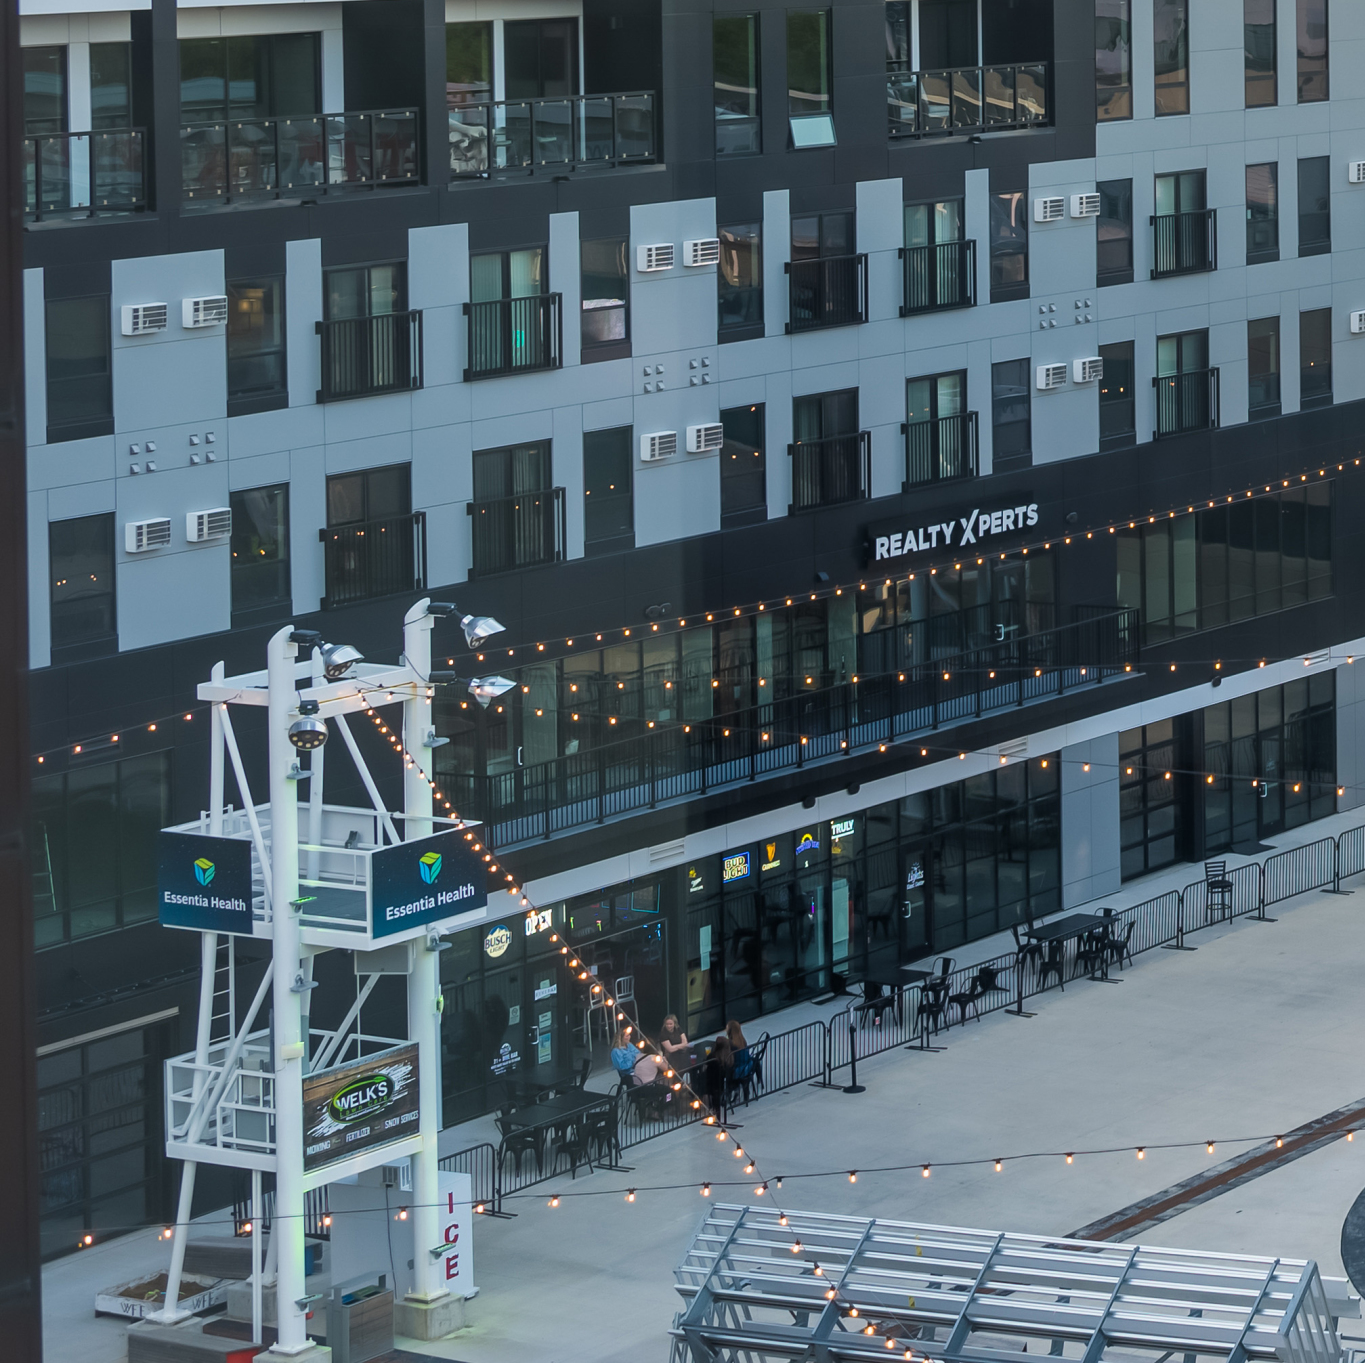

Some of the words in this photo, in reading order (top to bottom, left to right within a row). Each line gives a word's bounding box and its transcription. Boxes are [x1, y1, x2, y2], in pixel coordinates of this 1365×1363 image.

[875, 520, 956, 561] REALTY
[960, 503, 1039, 546] XPERTS
[831, 820, 855, 836] TRULY
[725, 855, 746, 869] BUD
[164, 890, 209, 908] Essentia
[211, 896, 246, 911] Health
[386, 896, 436, 922] Essentia
[438, 883, 475, 905] Health
[484, 931, 512, 951] BUSCH
[337, 1081, 388, 1109] WELK'S
[444, 1192, 459, 1280] ICE
